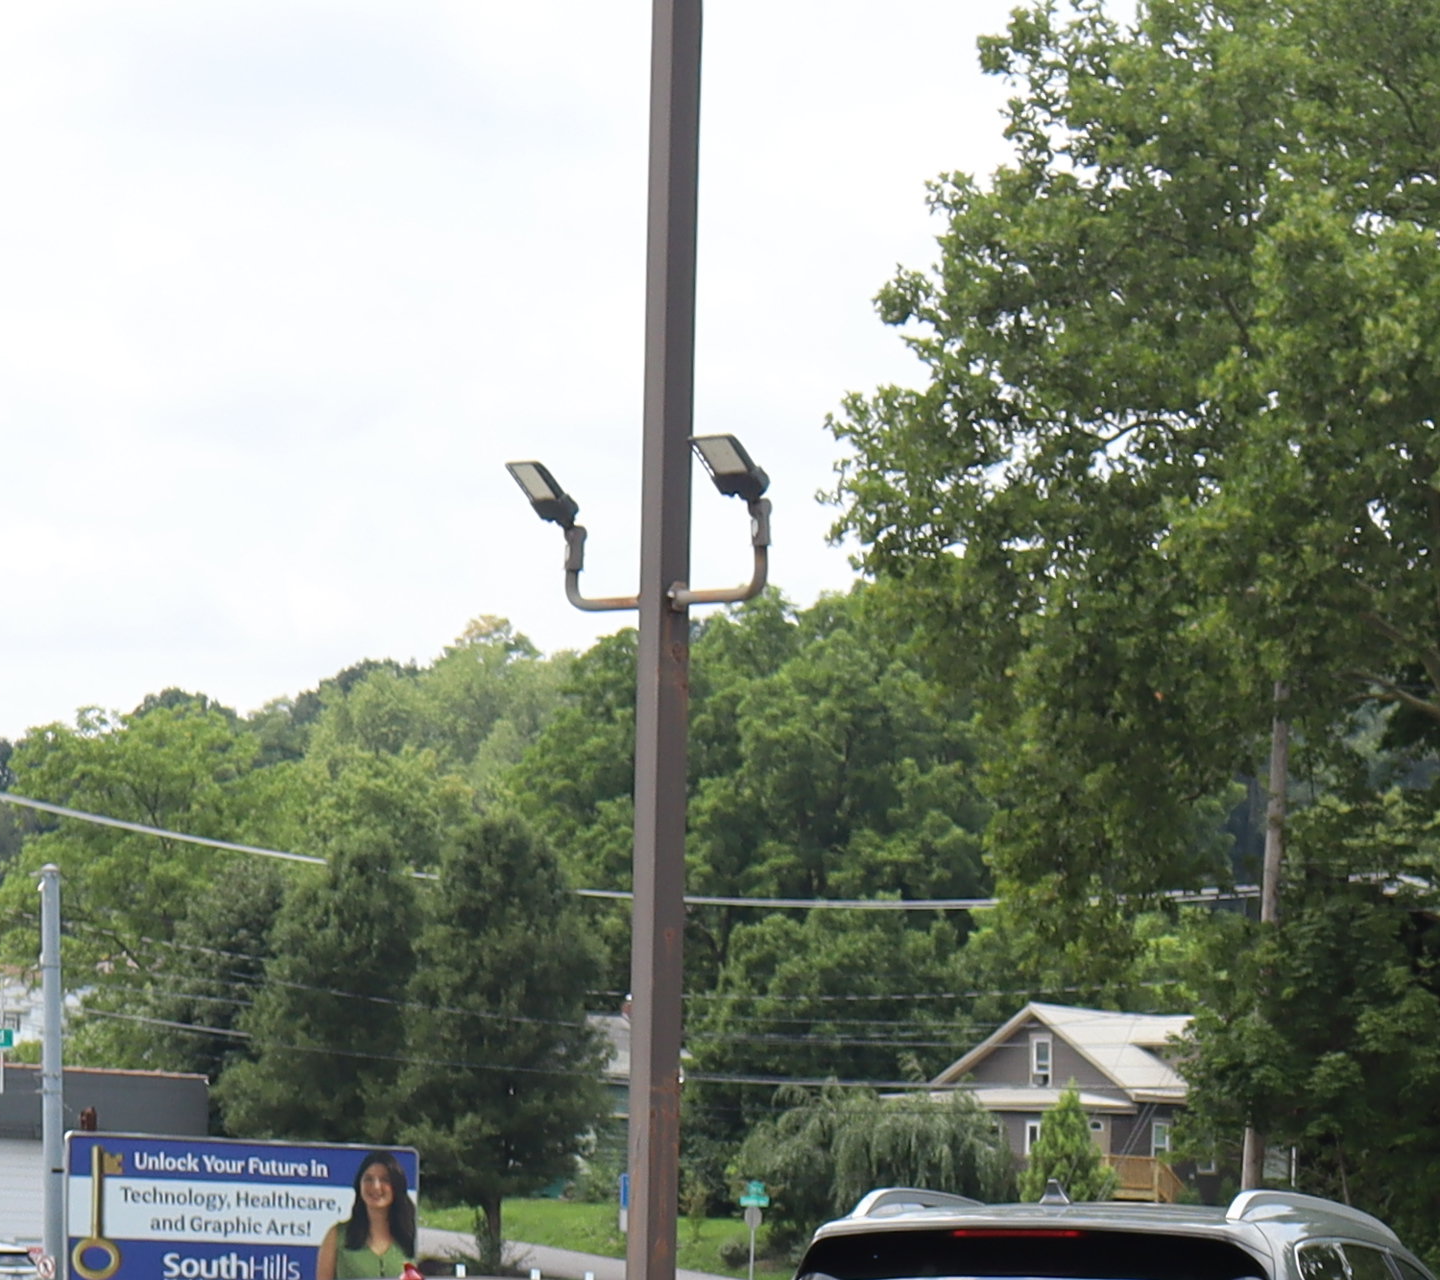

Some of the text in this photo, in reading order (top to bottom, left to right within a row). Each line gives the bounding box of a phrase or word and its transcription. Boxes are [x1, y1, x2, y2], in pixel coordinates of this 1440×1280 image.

[134, 1151, 329, 1178] Unlock Your Future in
[120, 1186, 342, 1214] Technology, Healthcare,
[150, 1214, 311, 1238] and Graphic Arts!
